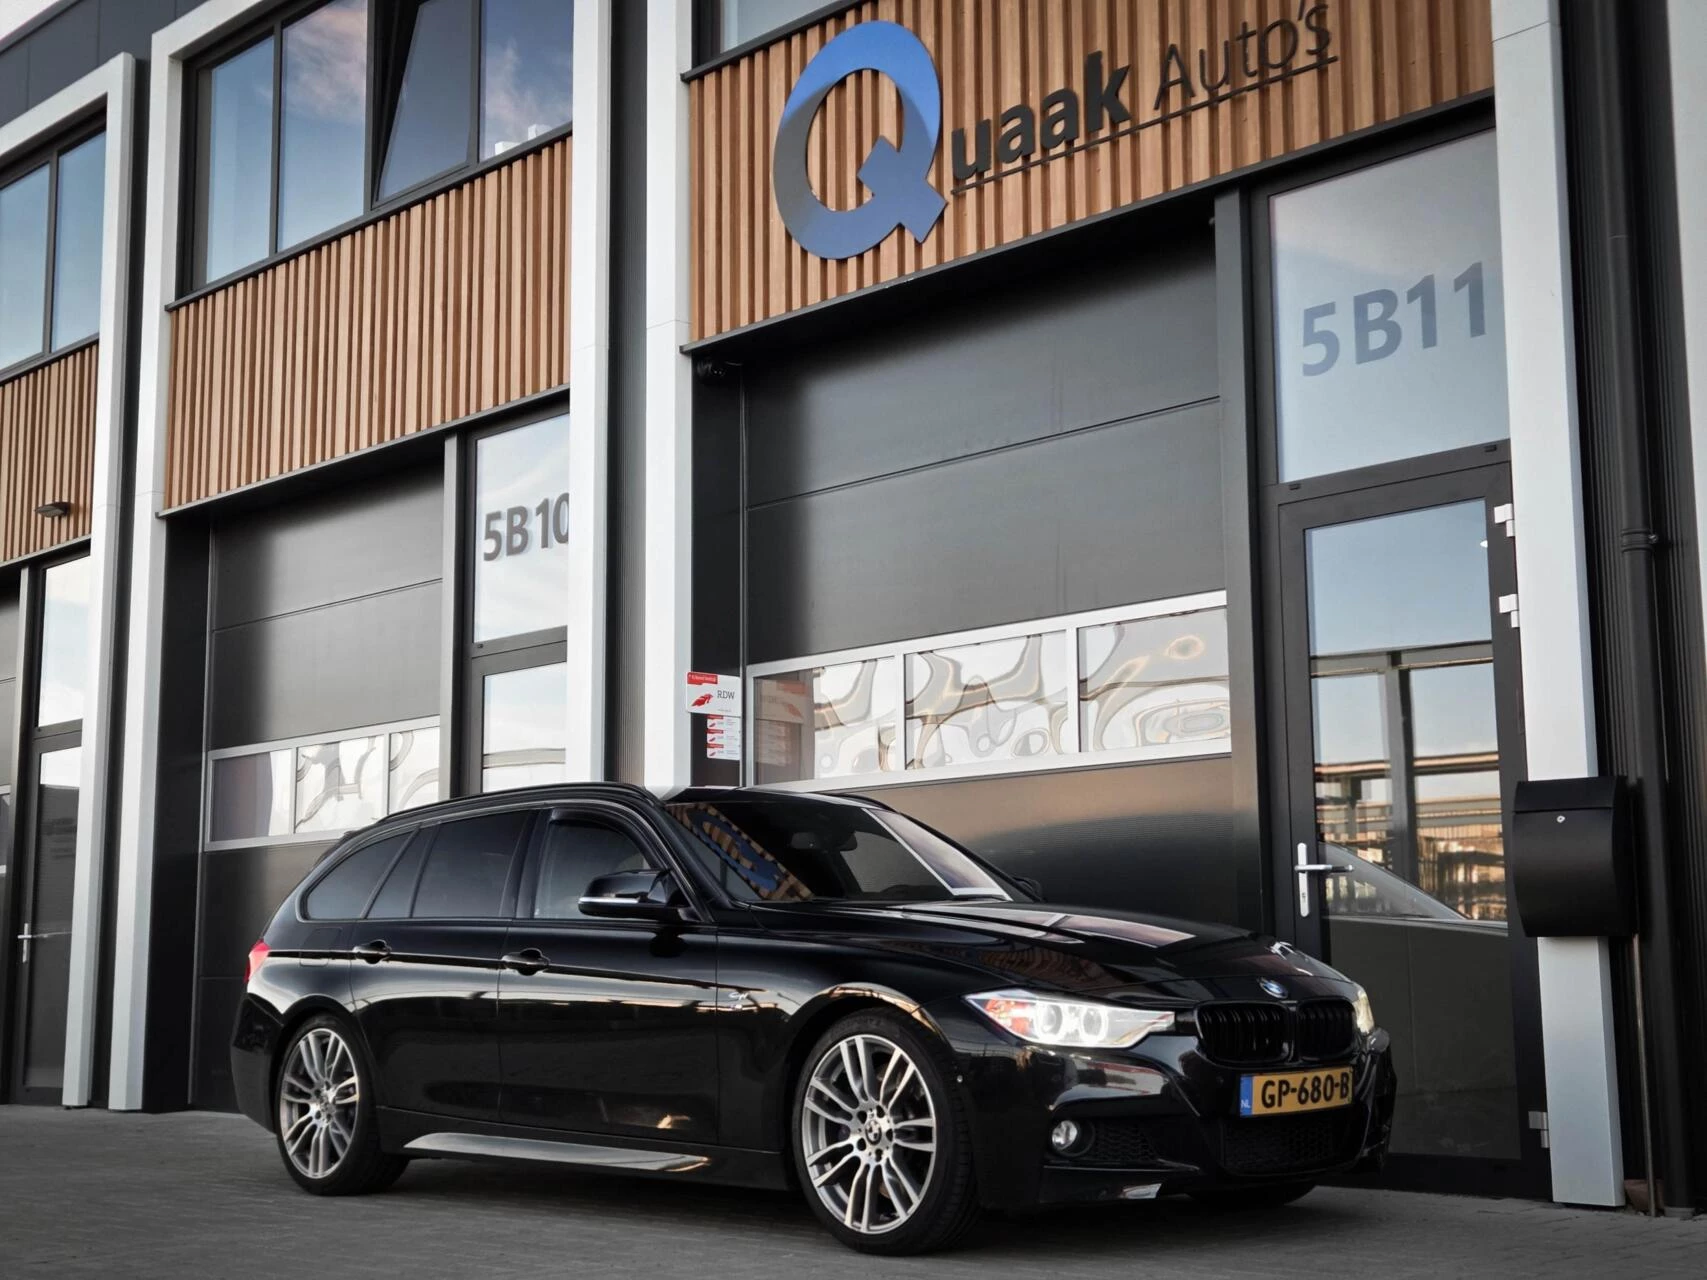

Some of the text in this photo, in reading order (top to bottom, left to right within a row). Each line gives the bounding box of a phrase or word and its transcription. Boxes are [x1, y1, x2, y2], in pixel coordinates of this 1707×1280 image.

[774, 2, 1332, 260] Quaak Auto's
[1302, 262, 1487, 377] 5B11
[483, 492, 569, 561] 5B10
[717, 690, 735, 699] RDW
[1240, 1099, 1251, 1109] NL
[1261, 1072, 1350, 1108] GP-680-B
